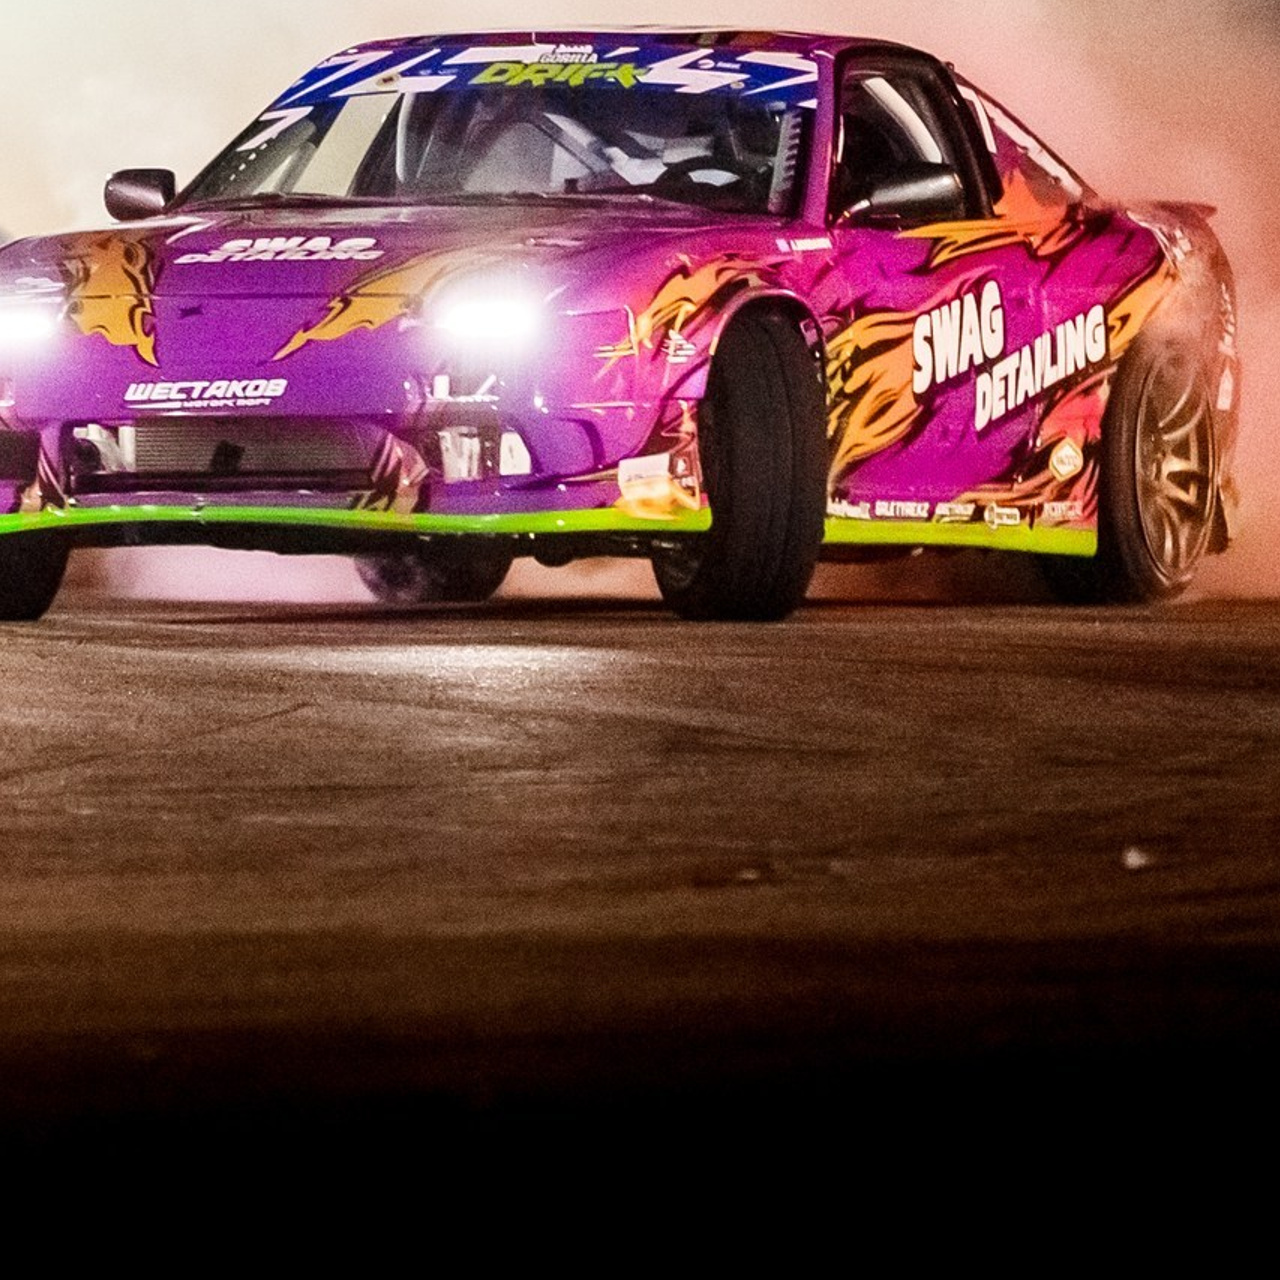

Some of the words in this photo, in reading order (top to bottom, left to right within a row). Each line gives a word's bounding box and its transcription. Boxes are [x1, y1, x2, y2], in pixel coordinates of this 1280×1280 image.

[467, 61, 651, 89] DRIFT
[912, 280, 1005, 395] SWAG
[974, 304, 1107, 433] DETAILING
